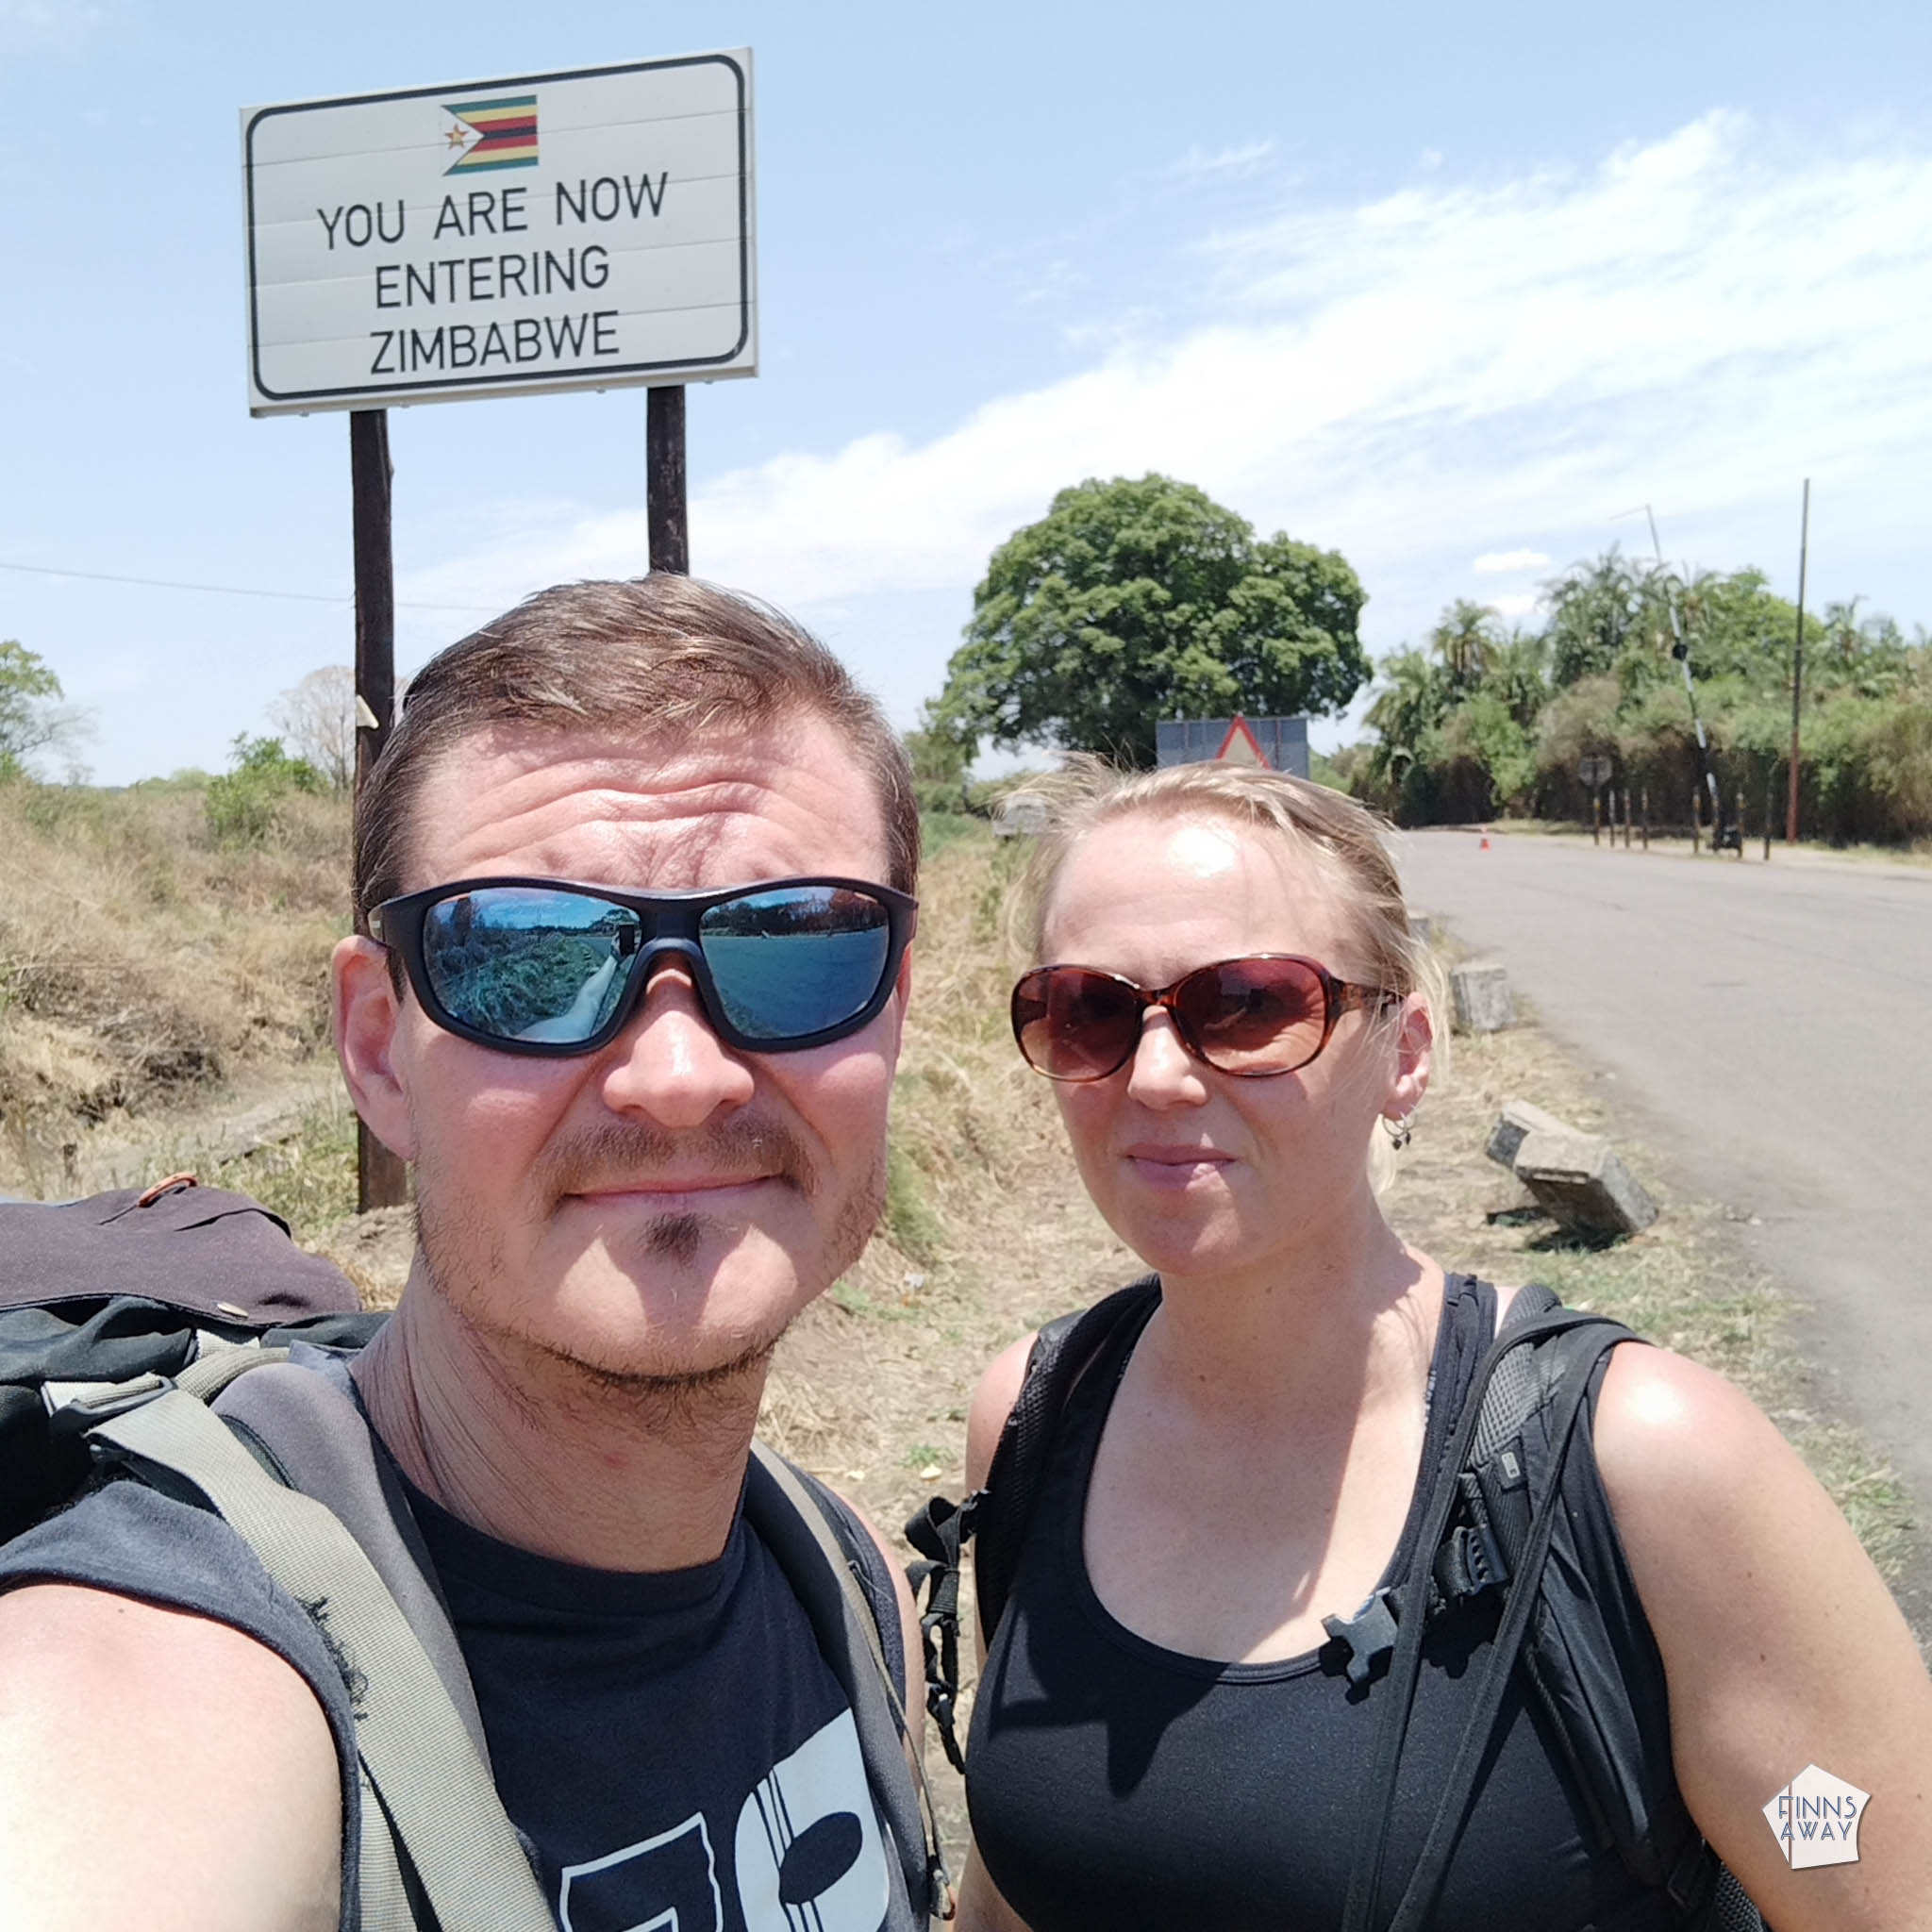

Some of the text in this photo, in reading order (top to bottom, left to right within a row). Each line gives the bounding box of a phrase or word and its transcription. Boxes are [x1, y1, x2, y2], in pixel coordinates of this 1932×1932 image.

[317, 171, 669, 251] YOU ARE NOW
[375, 244, 610, 309] ENTERING
[370, 309, 620, 375] ZIMBABWE
